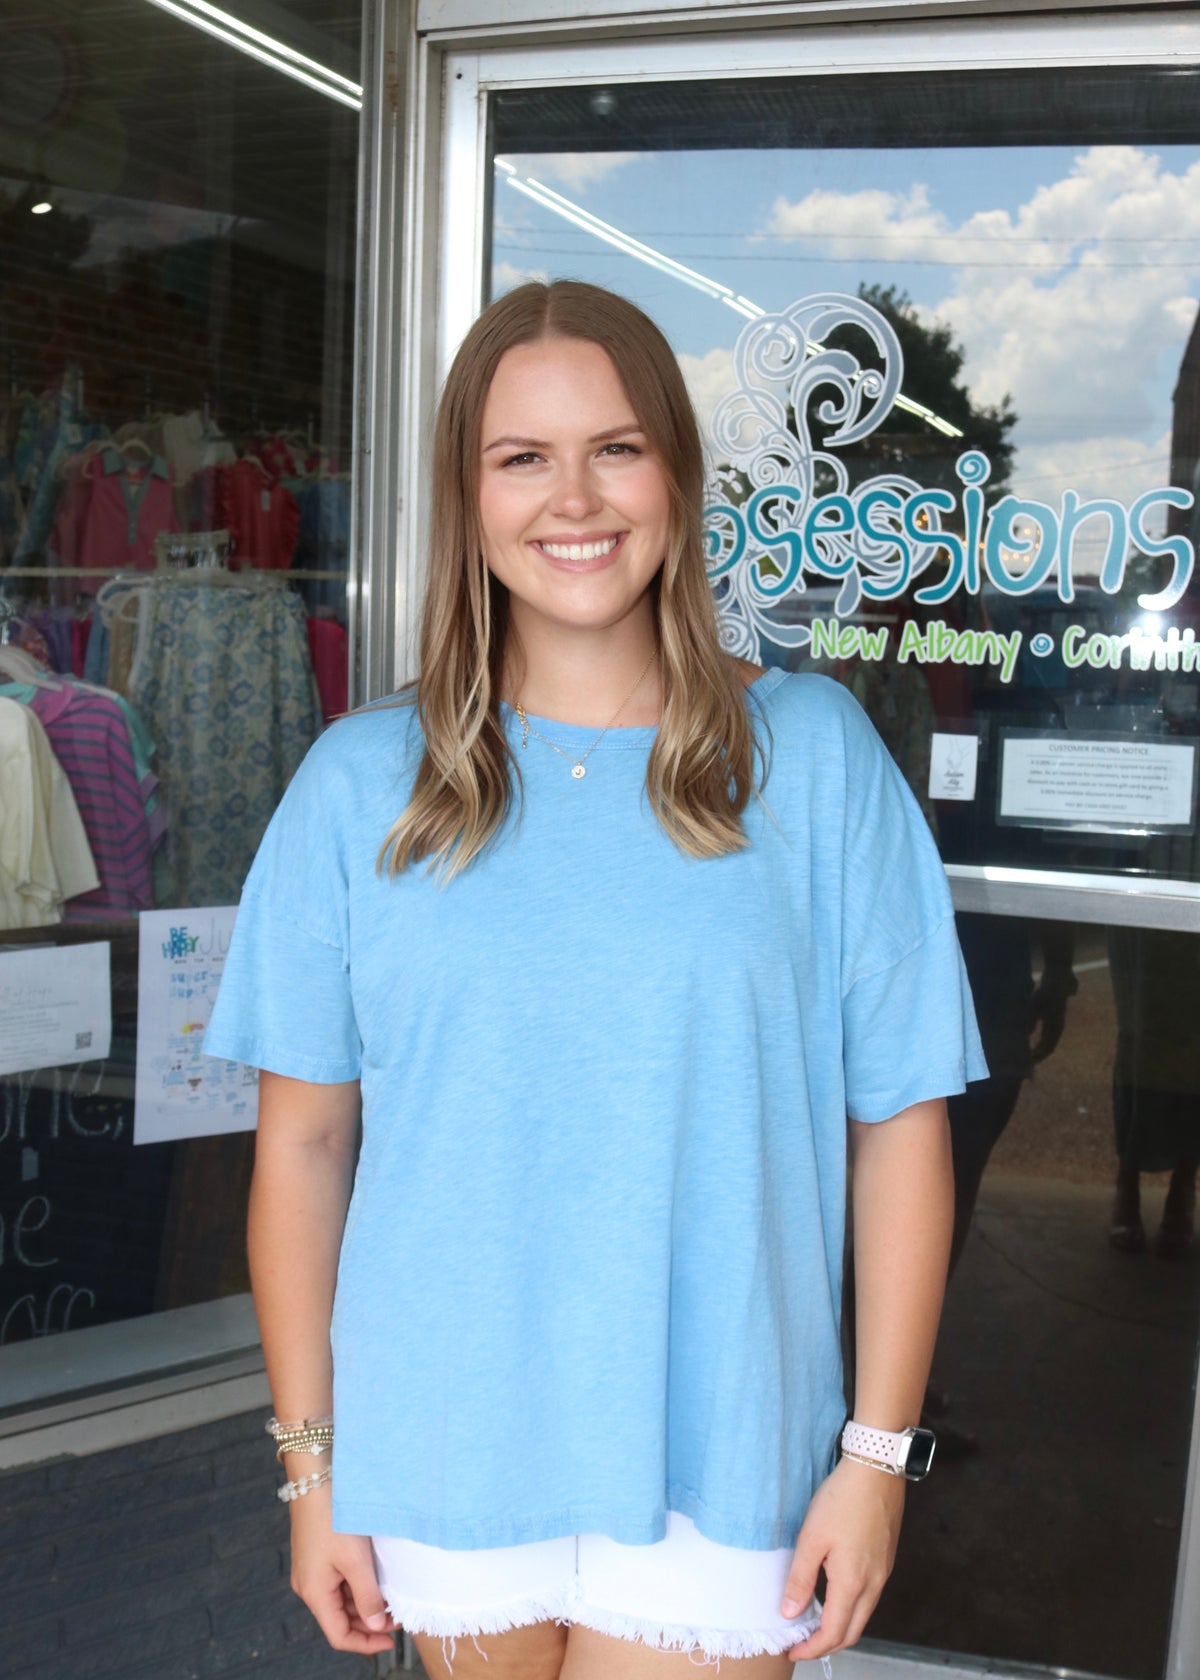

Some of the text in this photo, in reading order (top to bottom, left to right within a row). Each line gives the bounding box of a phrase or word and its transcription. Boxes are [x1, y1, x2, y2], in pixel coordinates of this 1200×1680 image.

[810, 617, 889, 662] New
[897, 618, 1023, 684] Albany
[1048, 744, 1149, 756] CUSTOMER PRICING NOTICE
